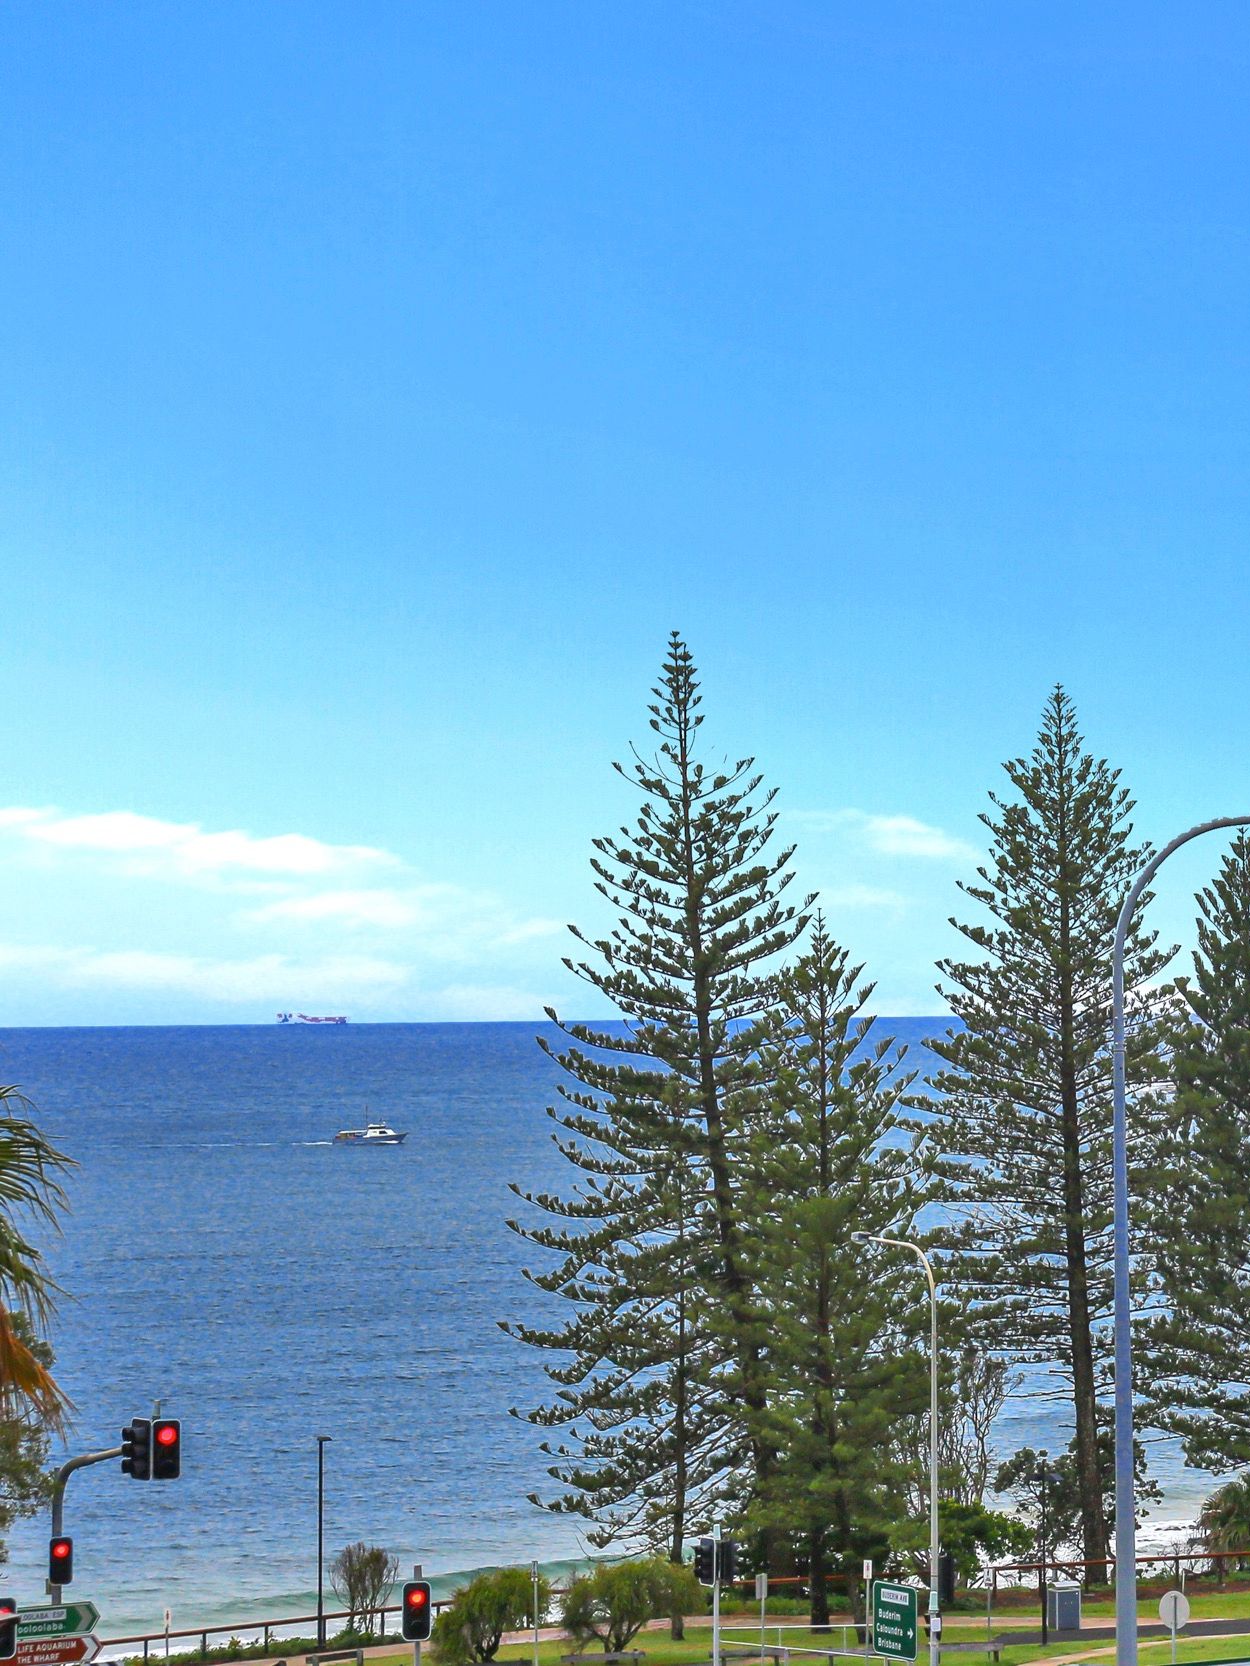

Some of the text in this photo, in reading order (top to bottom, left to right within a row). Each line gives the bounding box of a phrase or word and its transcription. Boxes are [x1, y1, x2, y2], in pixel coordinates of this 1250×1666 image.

[878, 1608, 901, 1621] Buderim
[17, 1623, 64, 1633] ooloolaba
[876, 1623, 903, 1636] Caloundra
[17, 1641, 76, 1653] LIFE AQUARIUM
[878, 1638, 901, 1650] Brisbane
[17, 1653, 60, 1664] THE WHARF
